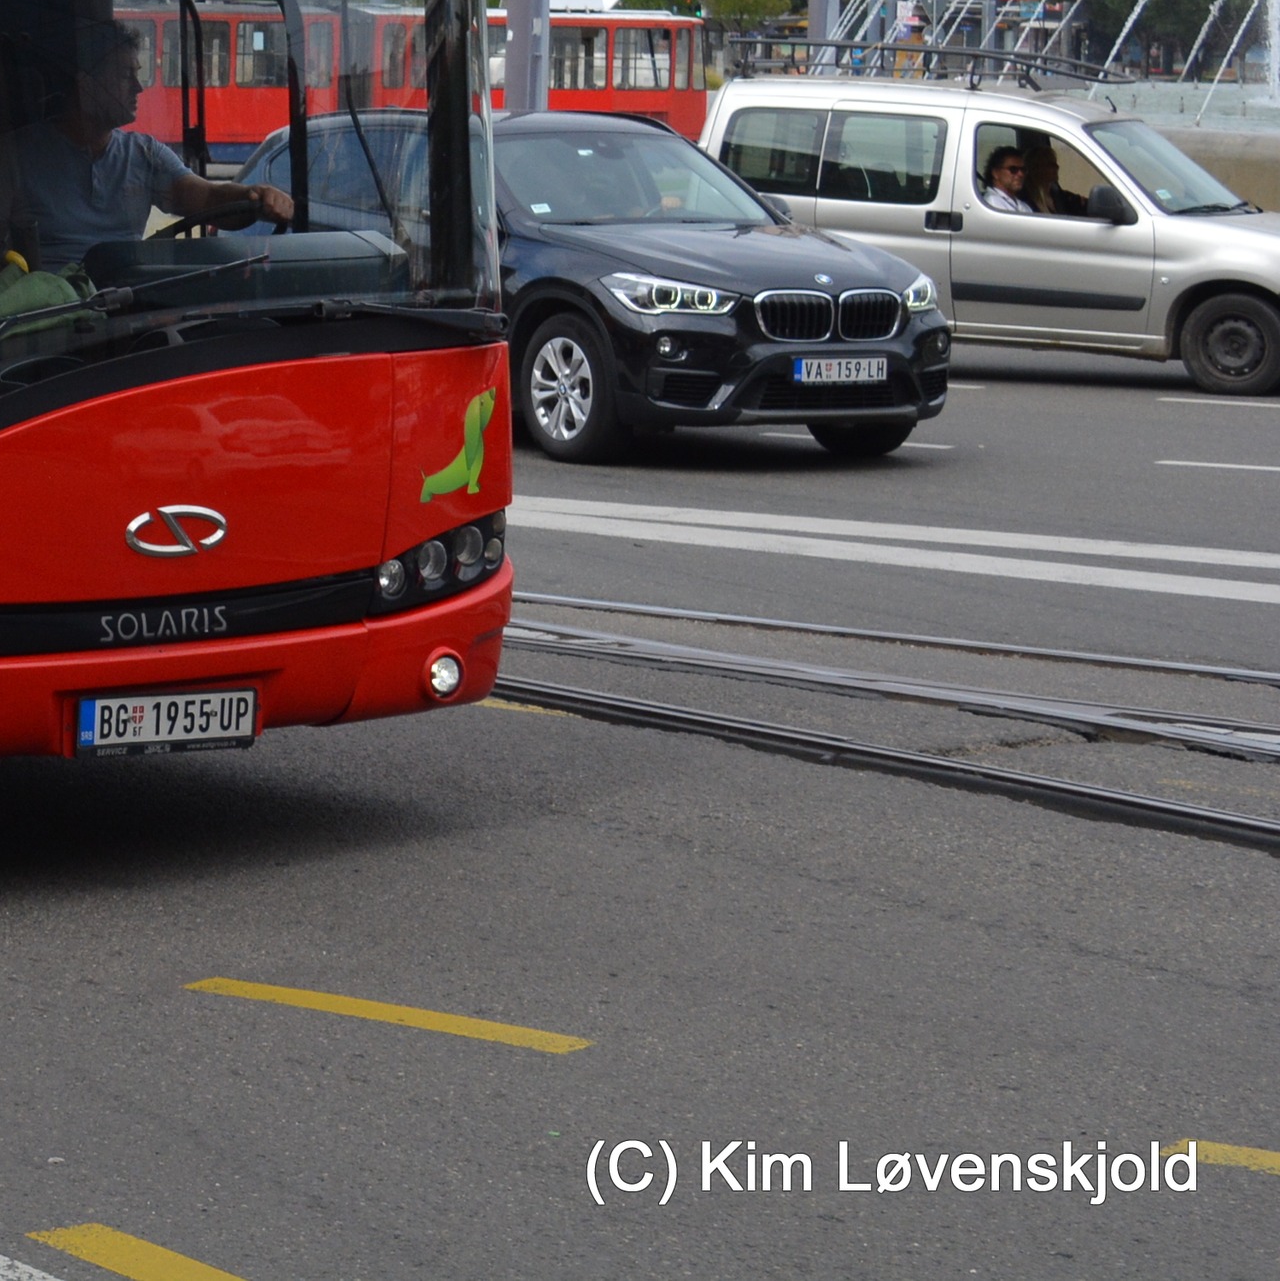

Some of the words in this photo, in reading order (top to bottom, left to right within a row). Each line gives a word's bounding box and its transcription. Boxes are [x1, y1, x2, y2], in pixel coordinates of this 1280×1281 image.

[805, 361, 823, 379] VA
[100, 606, 227, 642] SOLARIS
[99, 703, 129, 740] BG
